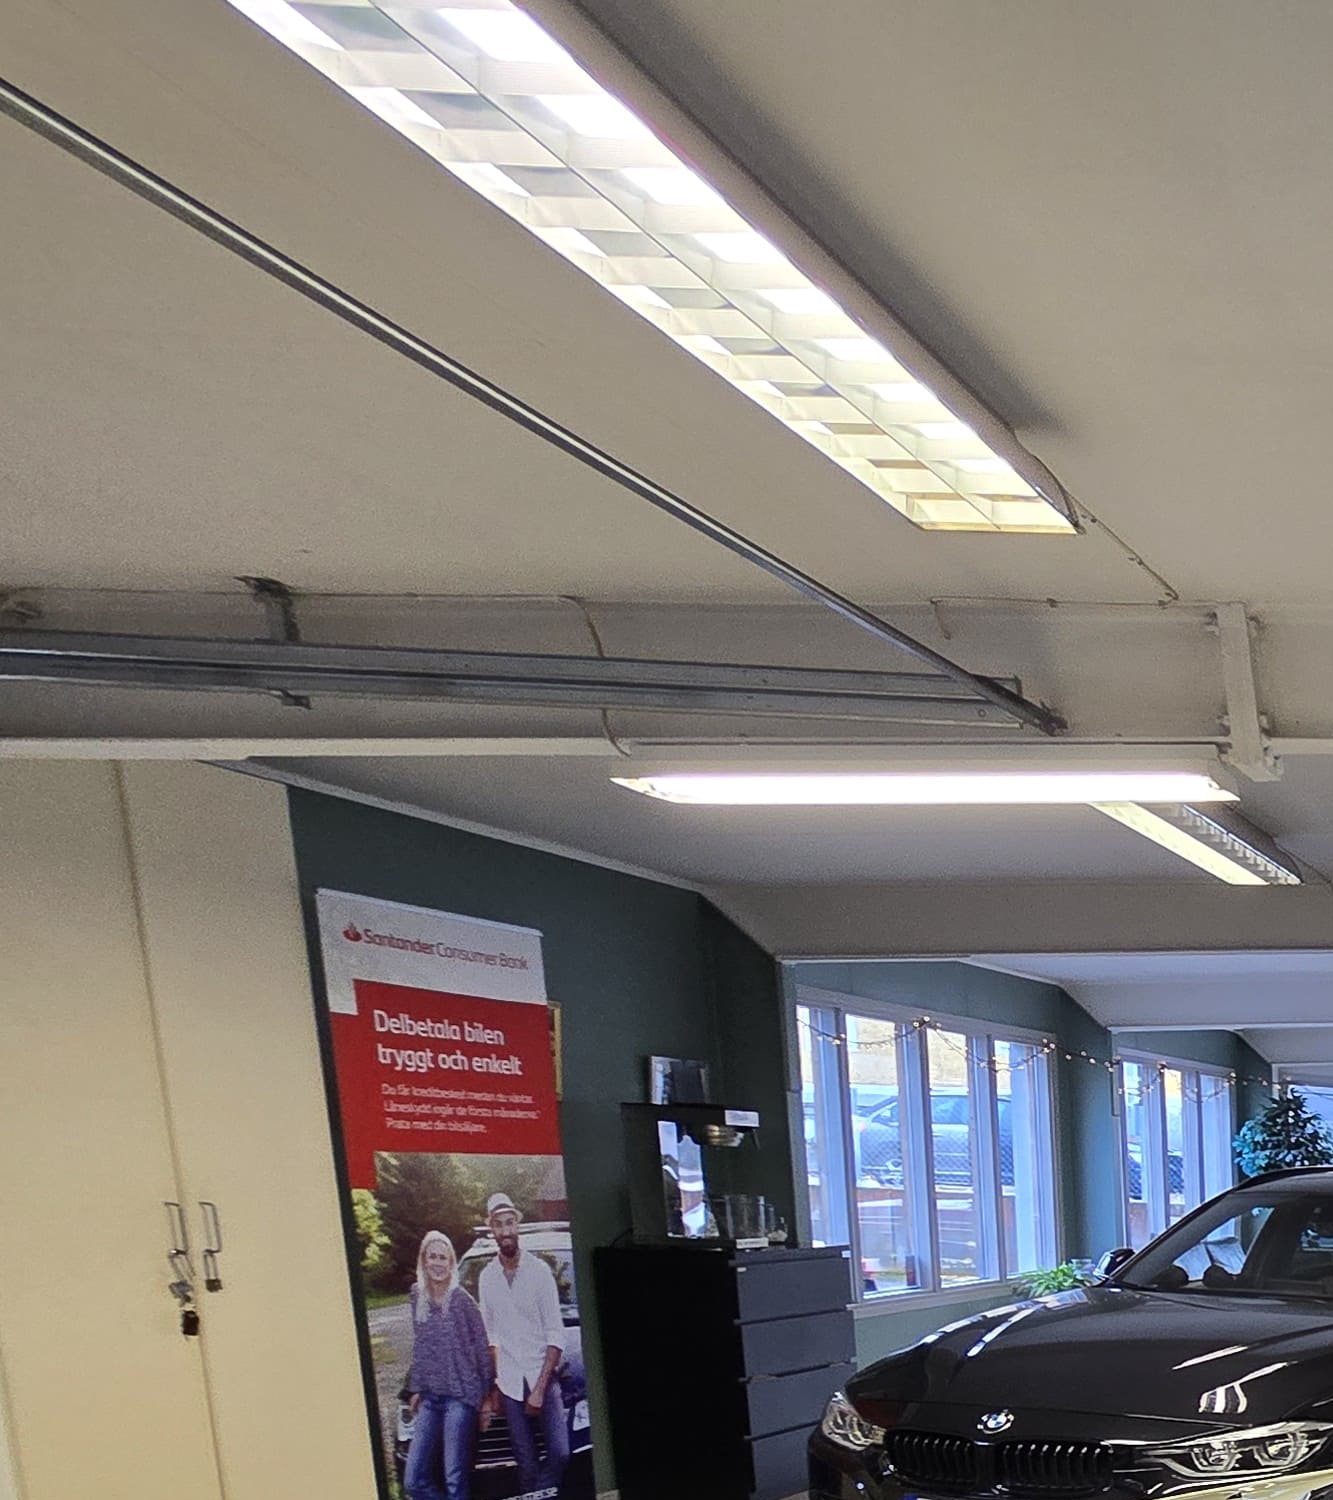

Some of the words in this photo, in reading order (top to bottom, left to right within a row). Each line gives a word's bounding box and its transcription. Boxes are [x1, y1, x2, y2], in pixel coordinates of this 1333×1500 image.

[363, 928, 435, 954] Santander
[436, 942, 500, 966] Consumer
[500, 953, 529, 970] Bank
[373, 1009, 461, 1041] Delbetala
[464, 1021, 505, 1045] bilen
[377, 1043, 435, 1073] tryggt
[438, 1049, 469, 1071] och
[472, 1053, 523, 1075] enkelt
